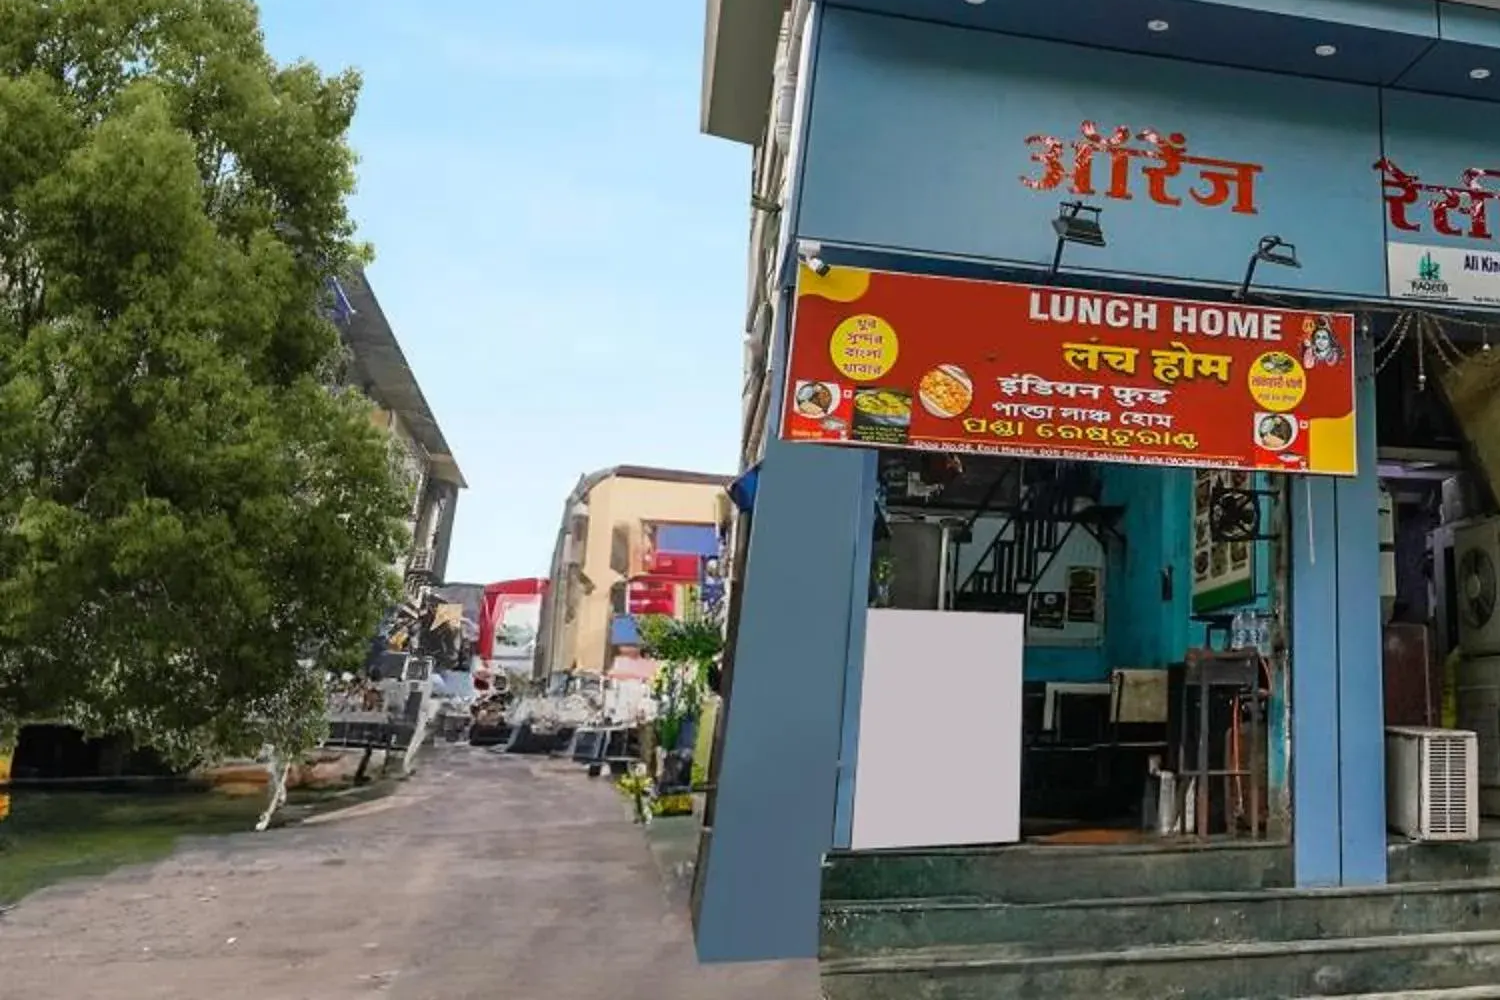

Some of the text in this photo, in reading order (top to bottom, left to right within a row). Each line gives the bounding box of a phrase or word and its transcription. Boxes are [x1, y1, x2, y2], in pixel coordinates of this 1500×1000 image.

[1029, 292, 1283, 341] LUNCH HOME
[1061, 337, 1232, 383] लंच होम
[996, 373, 1104, 399] इंडियन
